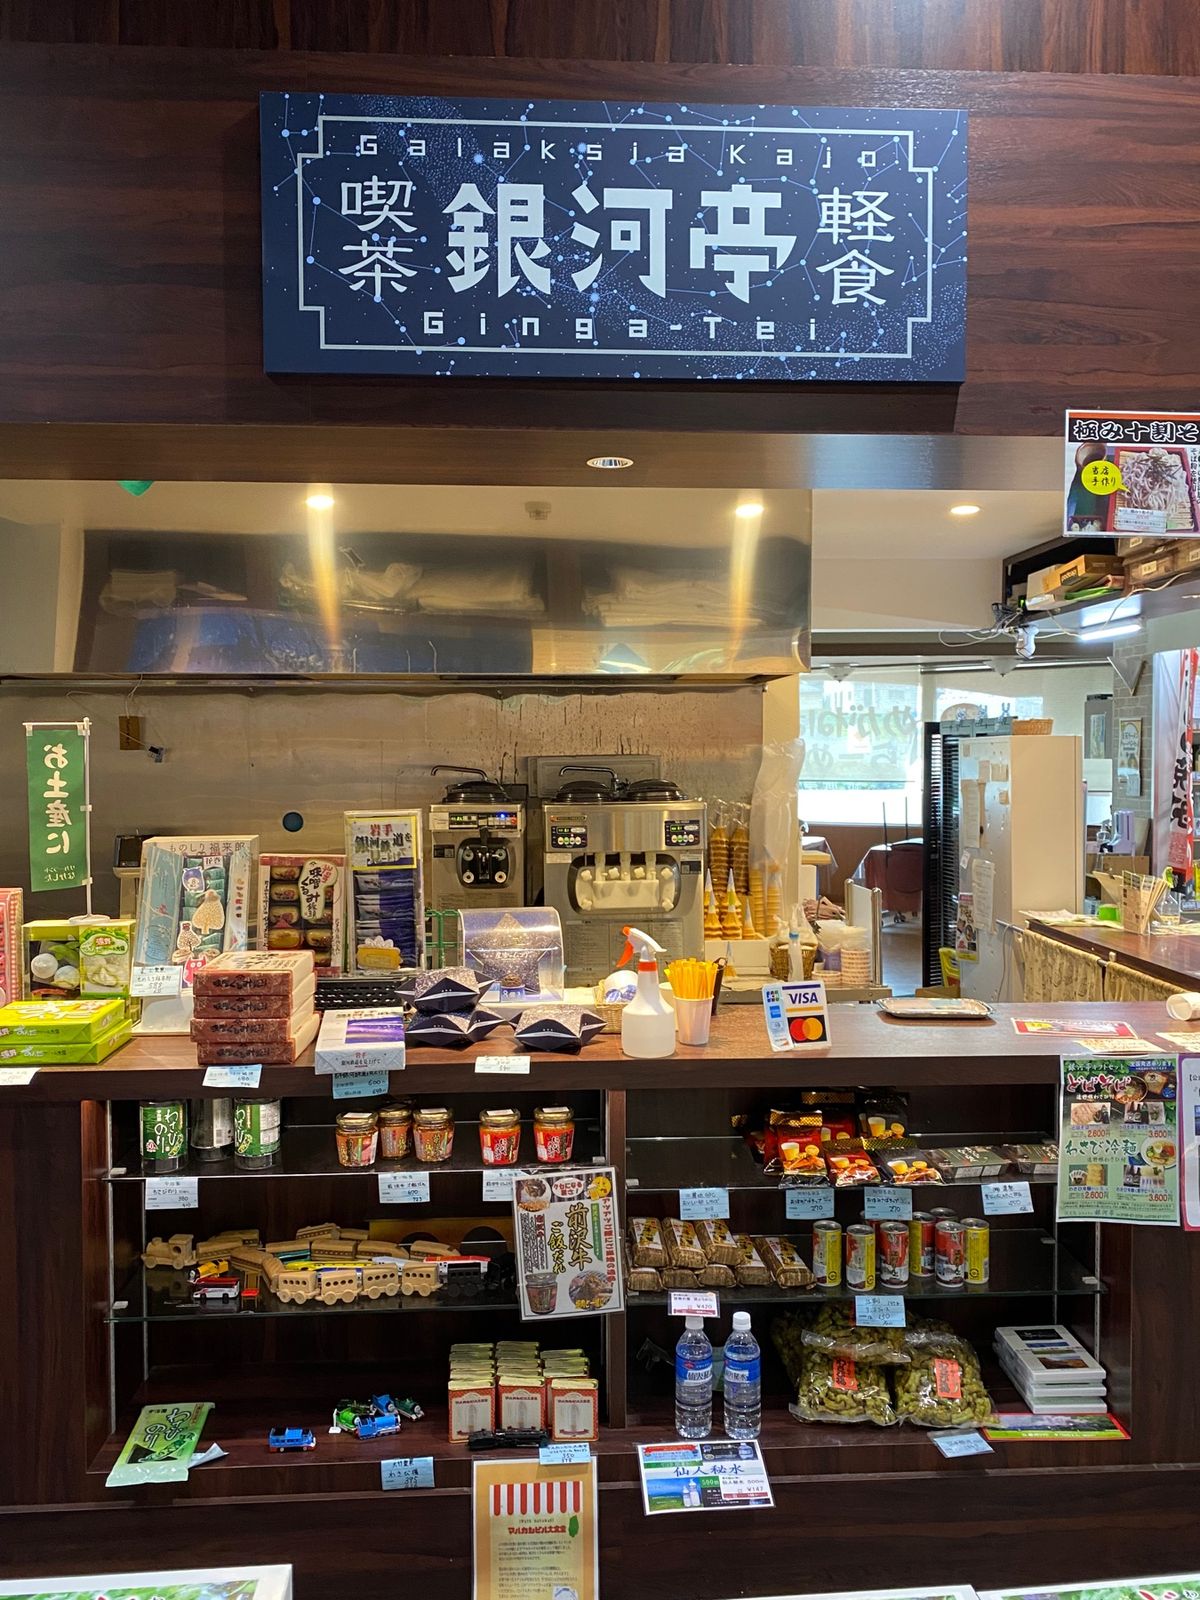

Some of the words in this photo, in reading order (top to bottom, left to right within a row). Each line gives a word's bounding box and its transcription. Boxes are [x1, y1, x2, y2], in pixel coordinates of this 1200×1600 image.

[359, 135, 686, 164] Galaksja
[729, 143, 877, 169] Kajo
[339, 174, 418, 299] 喫茶
[442, 182, 797, 304] 銀河亭
[815, 186, 896, 306] 軽食
[422, 311, 818, 342] Ginga-Tei
[788, 992, 819, 1005] VISA
[673, 1463, 746, 1478] 仙人秘水
